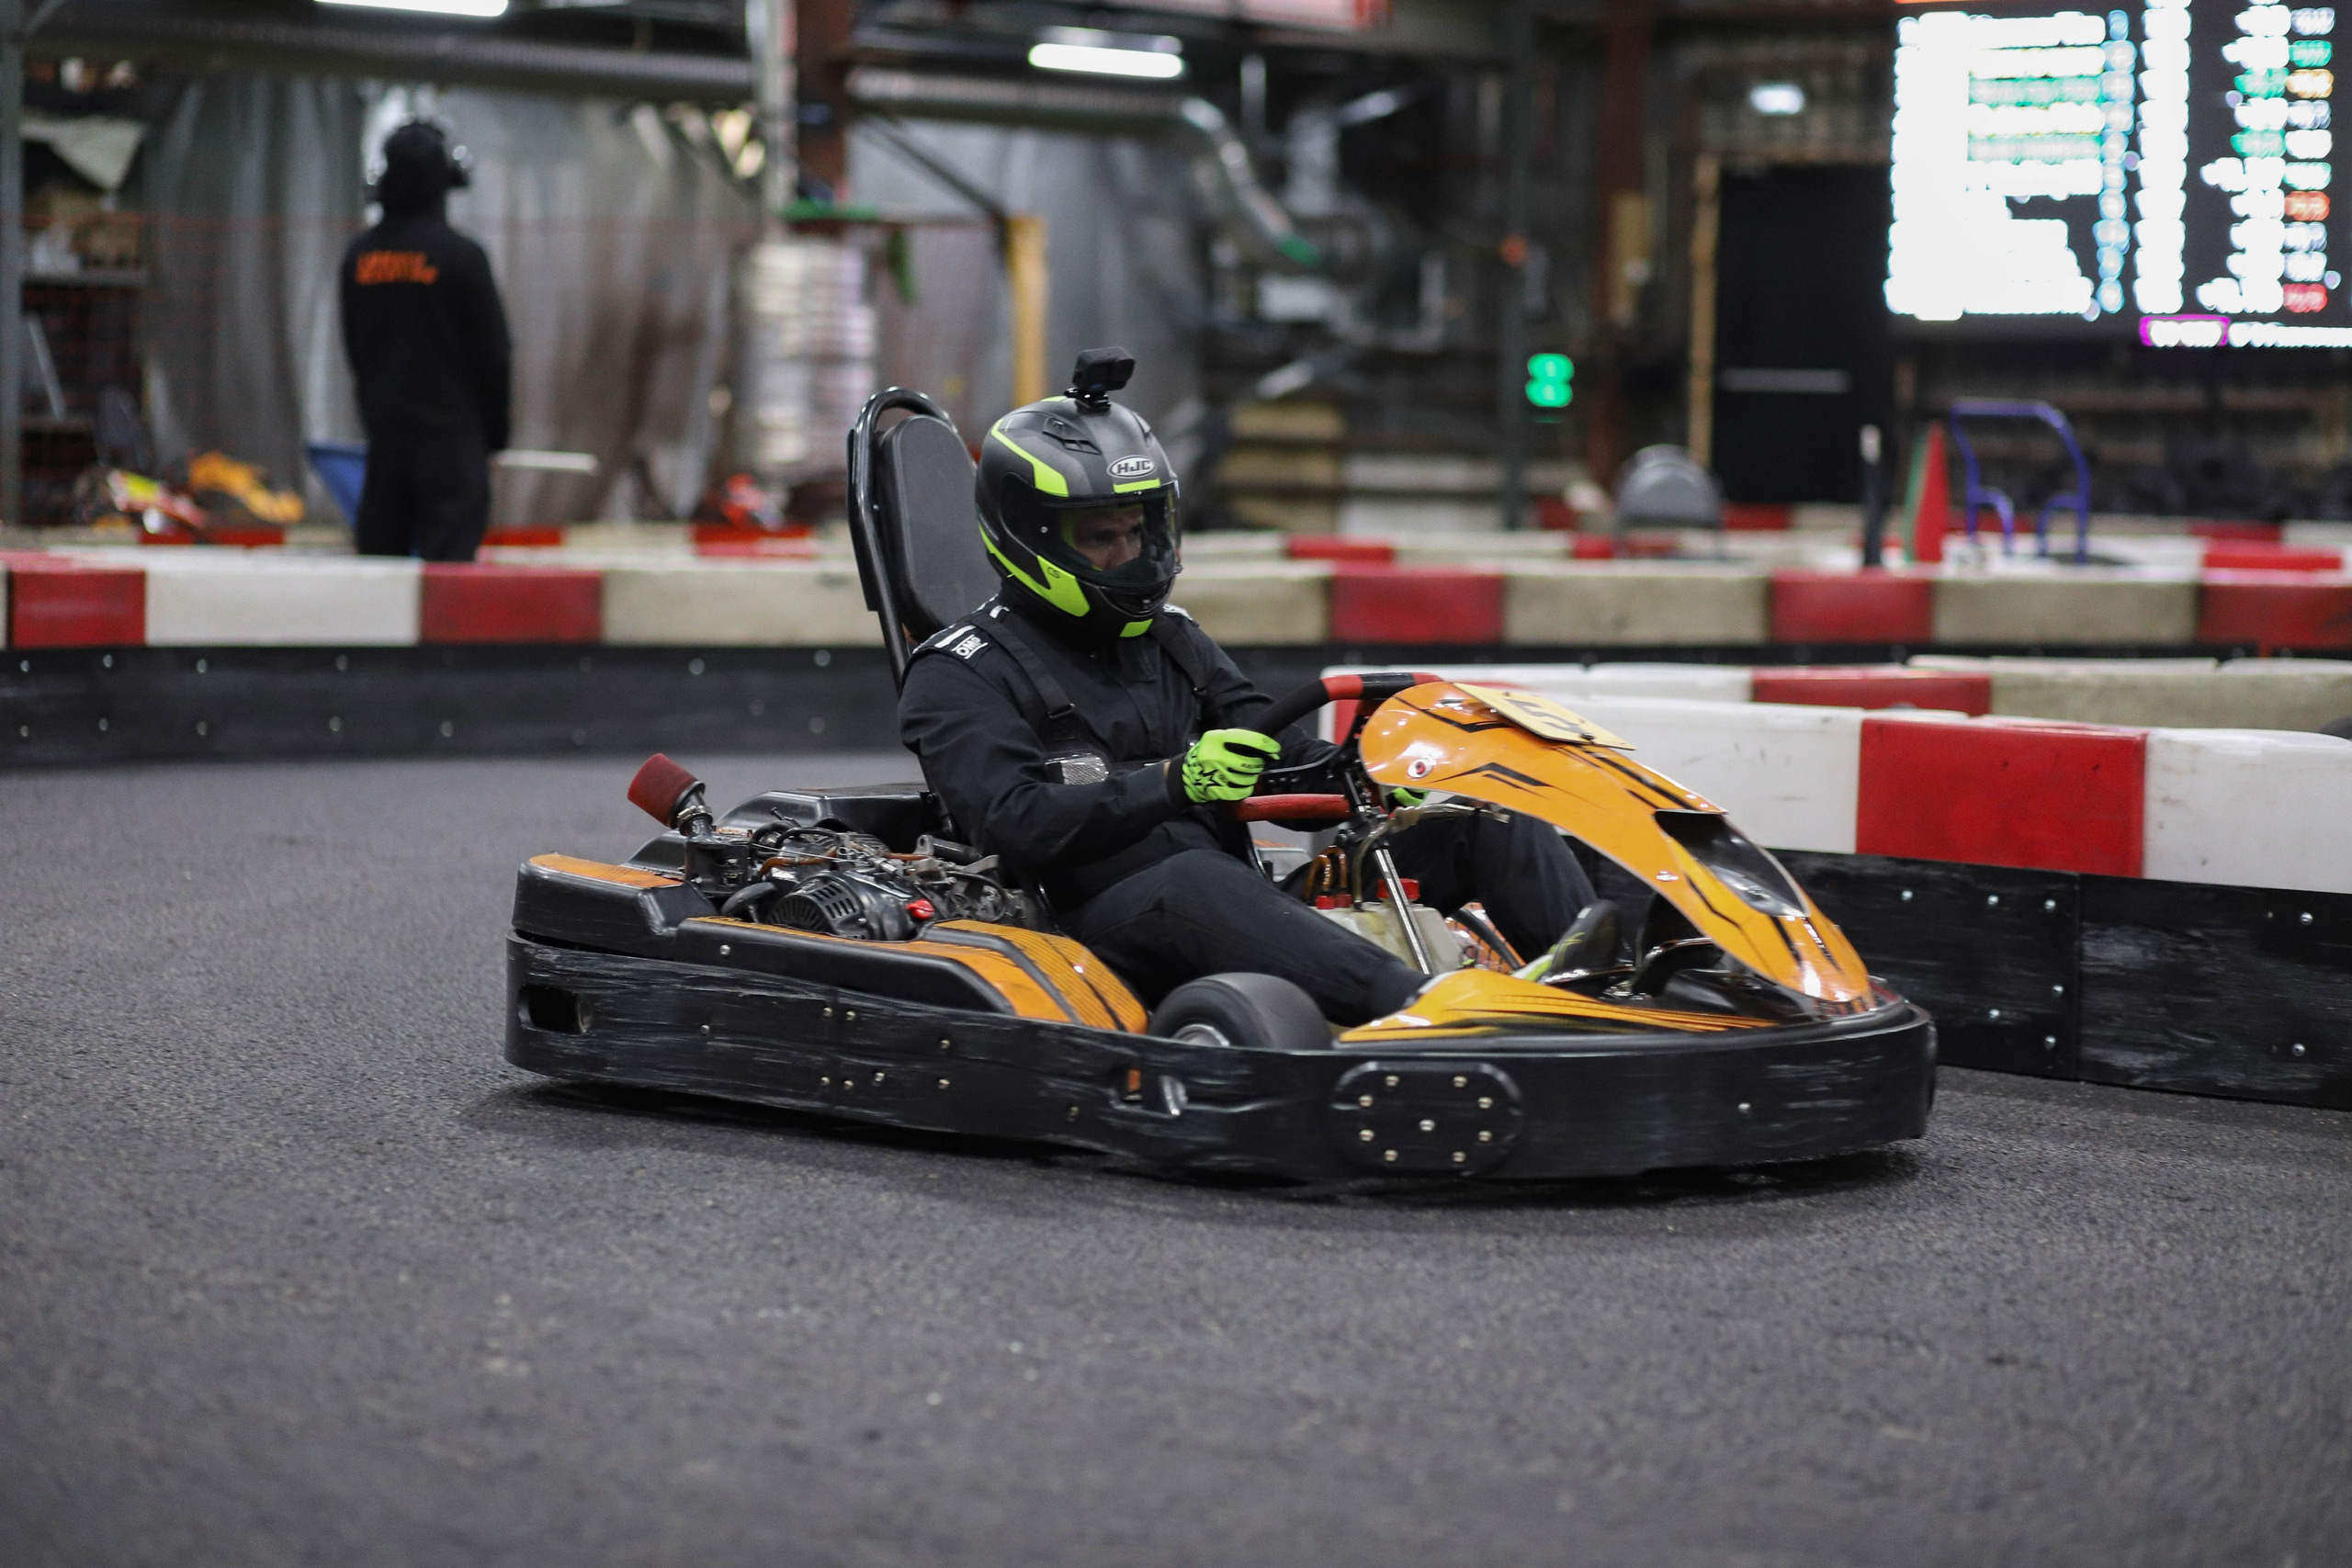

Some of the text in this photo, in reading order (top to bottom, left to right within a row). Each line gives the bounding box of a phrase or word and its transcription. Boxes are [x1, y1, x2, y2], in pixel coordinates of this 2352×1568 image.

[1115, 459, 1152, 475] HJC
[956, 636, 982, 657] OMP
[1502, 697, 1589, 735] 5
